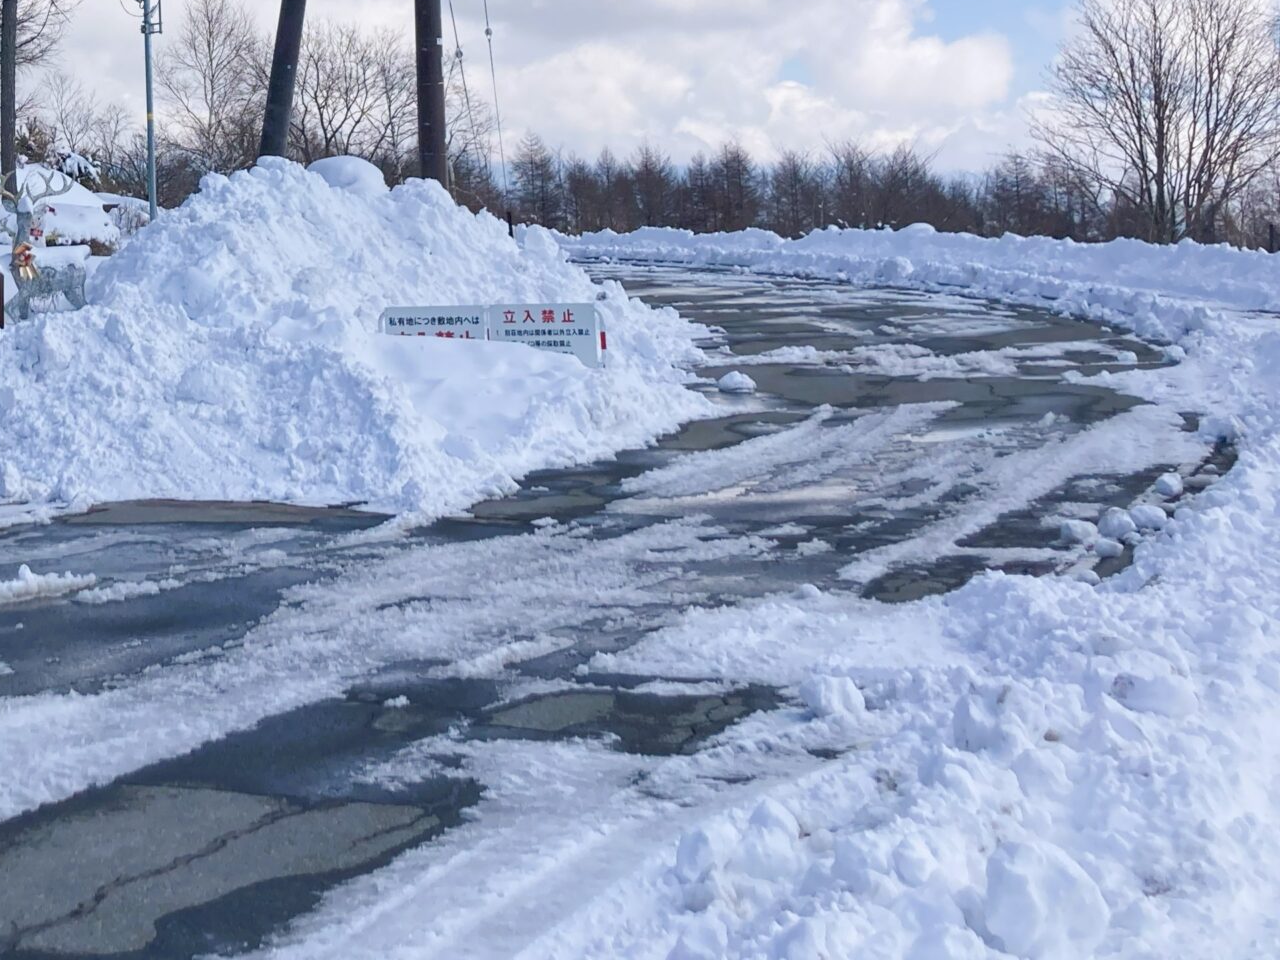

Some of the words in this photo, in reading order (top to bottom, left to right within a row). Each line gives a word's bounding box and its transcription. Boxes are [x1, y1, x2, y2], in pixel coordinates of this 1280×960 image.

[389, 316, 479, 326] 私有地につき敷地内へは
[502, 308, 575, 323] 立入禁止
